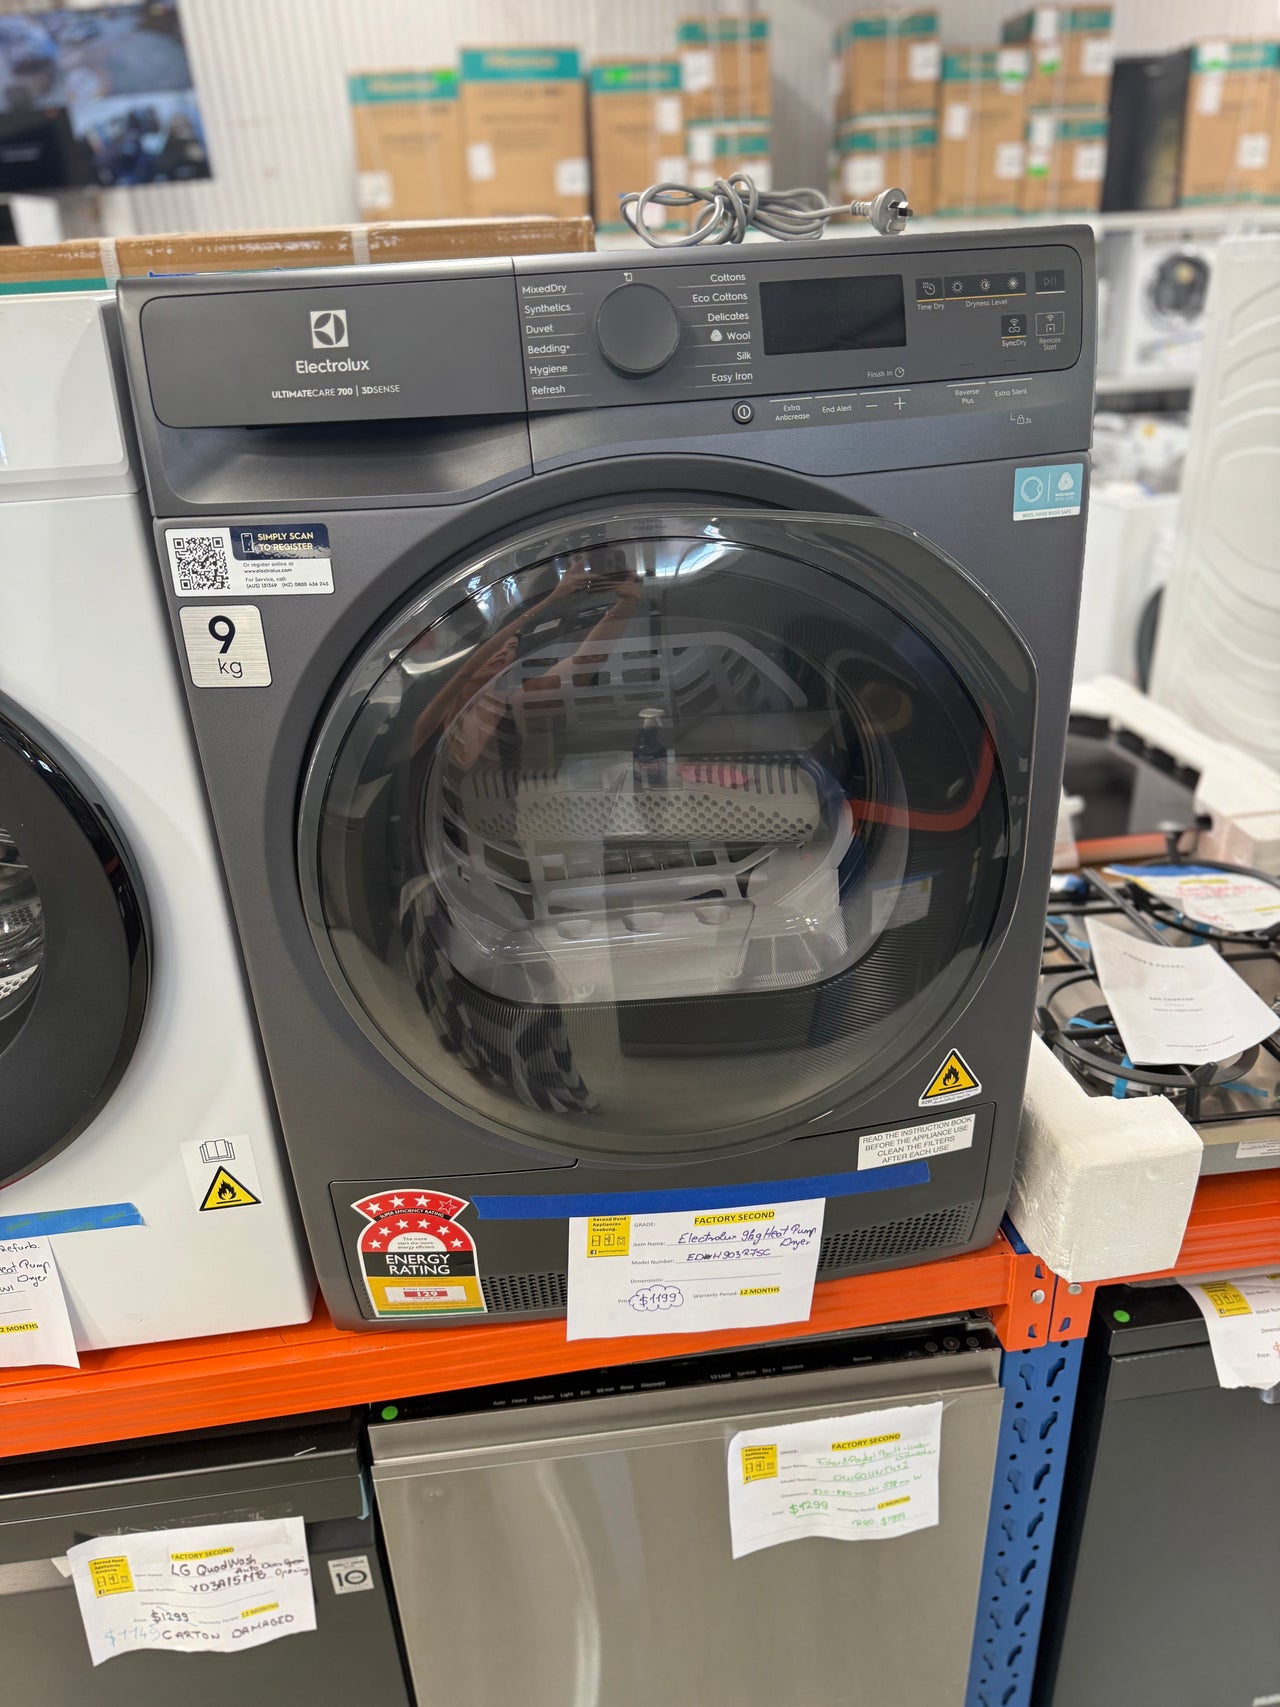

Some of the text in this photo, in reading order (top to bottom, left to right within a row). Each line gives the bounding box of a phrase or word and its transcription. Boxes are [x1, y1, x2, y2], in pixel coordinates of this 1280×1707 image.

[710, 273, 746, 282] Cottons
[522, 284, 566, 294] MixedDry
[692, 292, 748, 302] Eco Cottons
[524, 302, 571, 314] Synthetics
[917, 302, 945, 311] Time Dry
[965, 299, 1007, 309] Dryness Level
[708, 312, 749, 321] Delicates
[526, 324, 554, 334] Duvet
[727, 331, 751, 340] Wool
[1039, 337, 1061, 345] Remote
[1002, 339, 1027, 348] SyncDry
[736, 352, 751, 360] Silk
[296, 358, 370, 374] Electrolux
[530, 364, 568, 376] Hygiene
[712, 372, 753, 383] Easy Iron
[867, 370, 884, 378] Finish
[272, 385, 400, 399] ULTIMATECARE 700 3DSENSE
[531, 384, 566, 395] Refresh
[955, 388, 980, 397] Reverse
[995, 388, 1027, 398] Extra Silent
[836, 404, 852, 412] Alert
[775, 412, 810, 421] Anticrease
[258, 532, 314, 541] SIMPLY SCAN
[273, 542, 313, 550] REGISTER
[208, 615, 236, 654] 9
[218, 658, 243, 678] kg
[863, 1116, 972, 1144] READ THE INSTRUCTION BOOK
[865, 1141, 894, 1151] BEFORE
[912, 1129, 952, 1142] APPLIANCE
[953, 1125, 968, 1133] USE
[877, 1147, 904, 1157] CLEAN
[924, 1136, 955, 1148] FILTERS
[882, 1145, 948, 1164] AFTER EACH USE
[694, 1211, 775, 1225] FACTORY SECOND
[764, 1225, 790, 1239] Heat
[791, 1224, 816, 1238] Pump
[780, 1238, 810, 1250] Dryer
[385, 1254, 450, 1265] ENERGY
[19, 1259, 50, 1274] Pump
[390, 1265, 450, 1275] RATING
[639, 1293, 676, 1307] $1199
[7, 1323, 38, 1332] MONTHS
[832, 1434, 900, 1450] FACTORY SECOND
[789, 1501, 828, 1515] $1299
[171, 1547, 234, 1560] FACTORY SECOND
[171, 1564, 190, 1576] LG
[336, 1569, 367, 1587] 10
[151, 1609, 190, 1623] $1299
[162, 1630, 221, 1640] CARTON
[232, 1614, 294, 1639] DAMAGED
